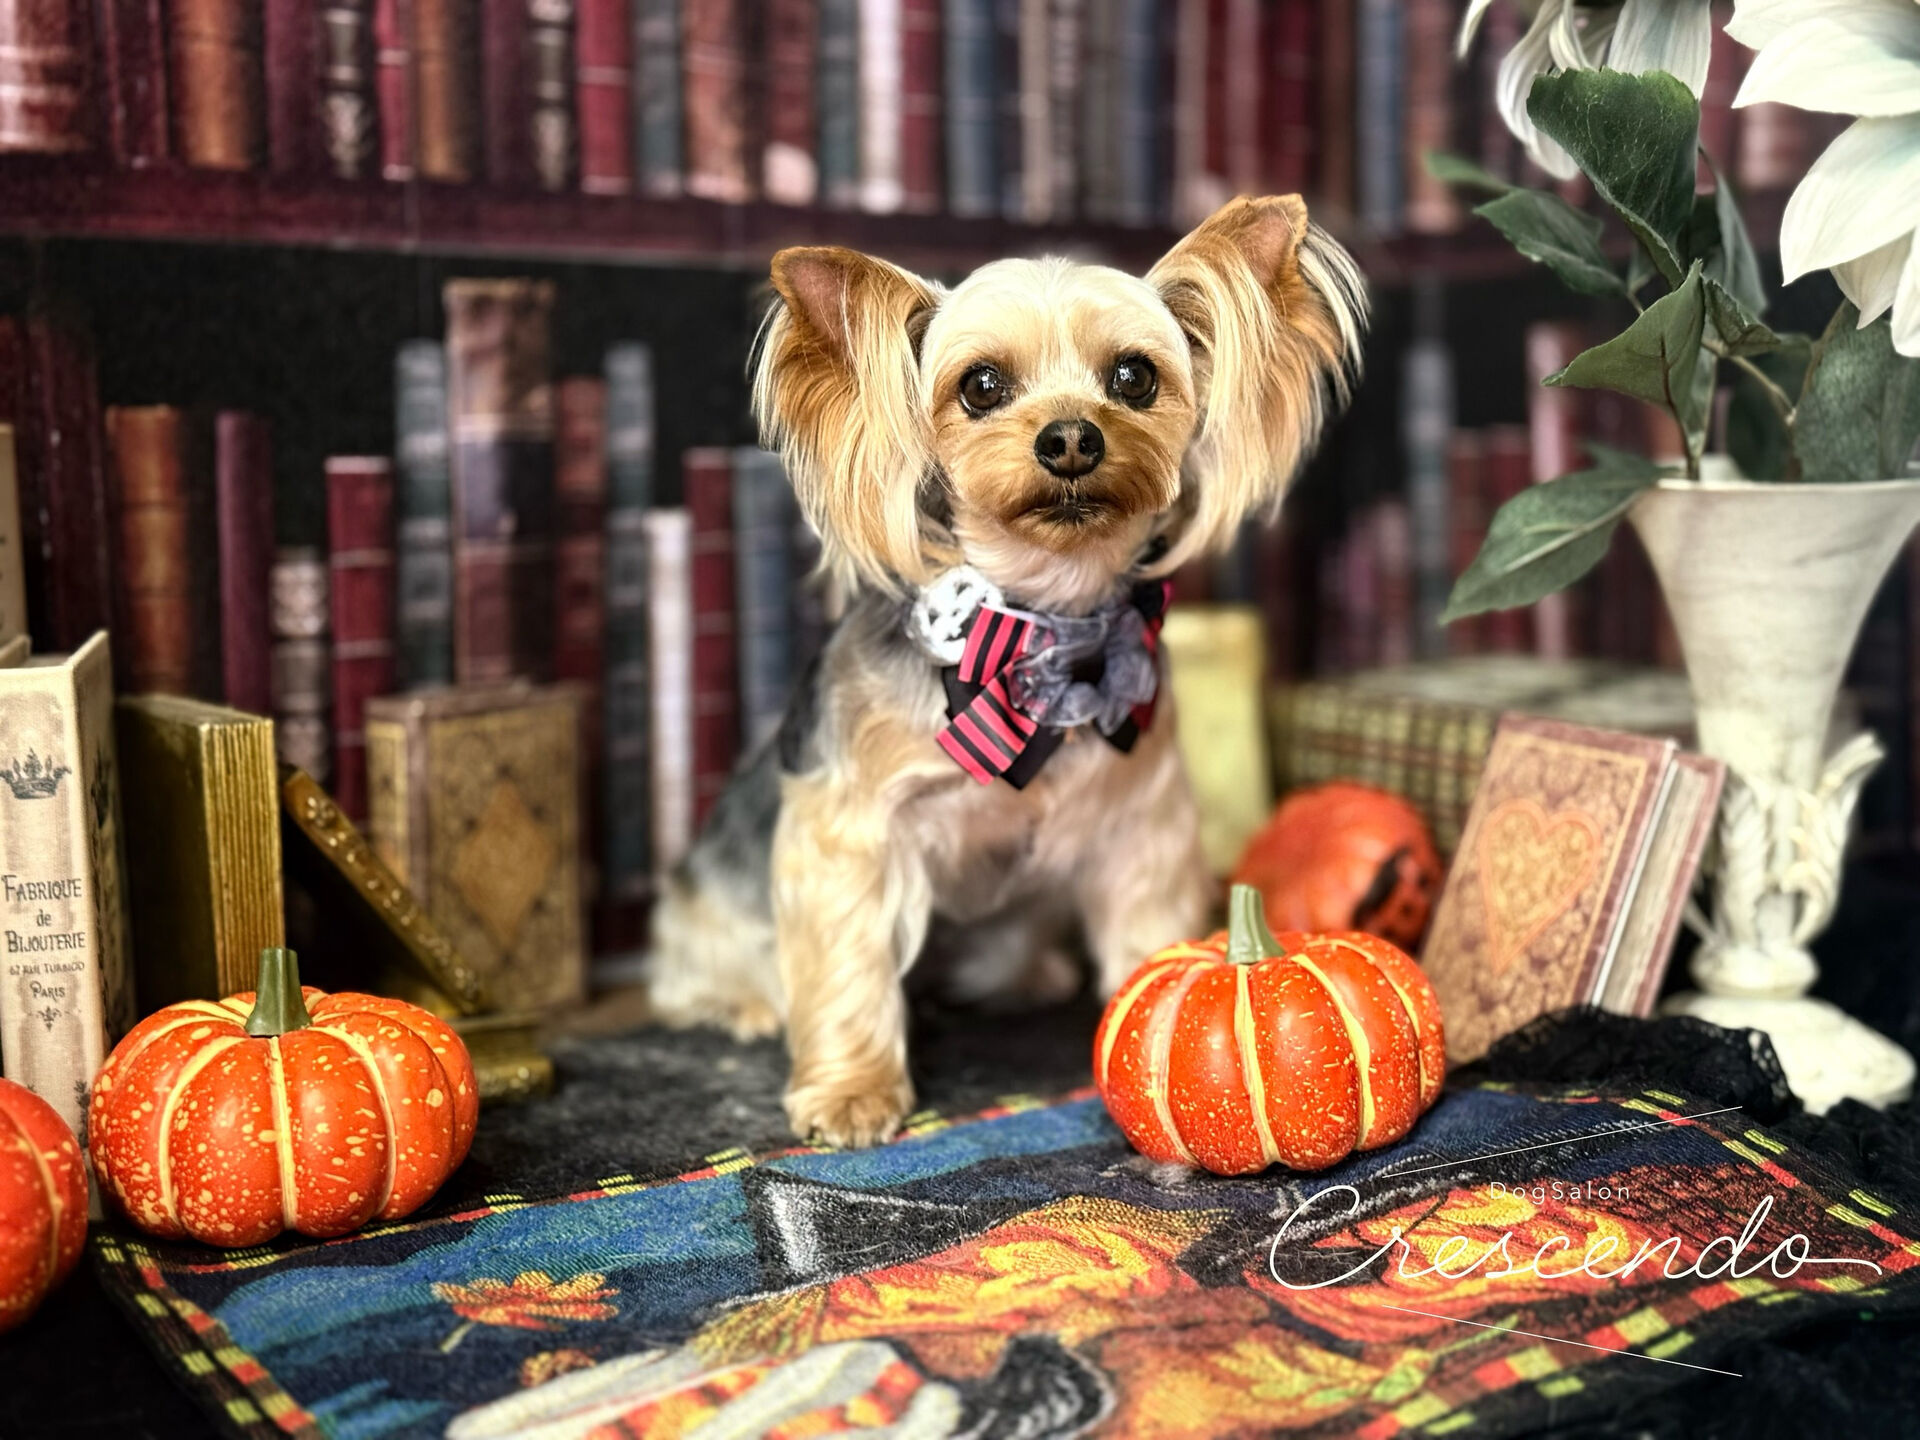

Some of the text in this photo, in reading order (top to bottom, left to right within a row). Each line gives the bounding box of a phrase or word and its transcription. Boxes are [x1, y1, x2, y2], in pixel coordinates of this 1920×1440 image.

[1, 874, 82, 902] FABRIQUE
[36, 908, 52, 927] de
[5, 929, 86, 953] BIJOUTERIE
[29, 980, 66, 1003] PARIS
